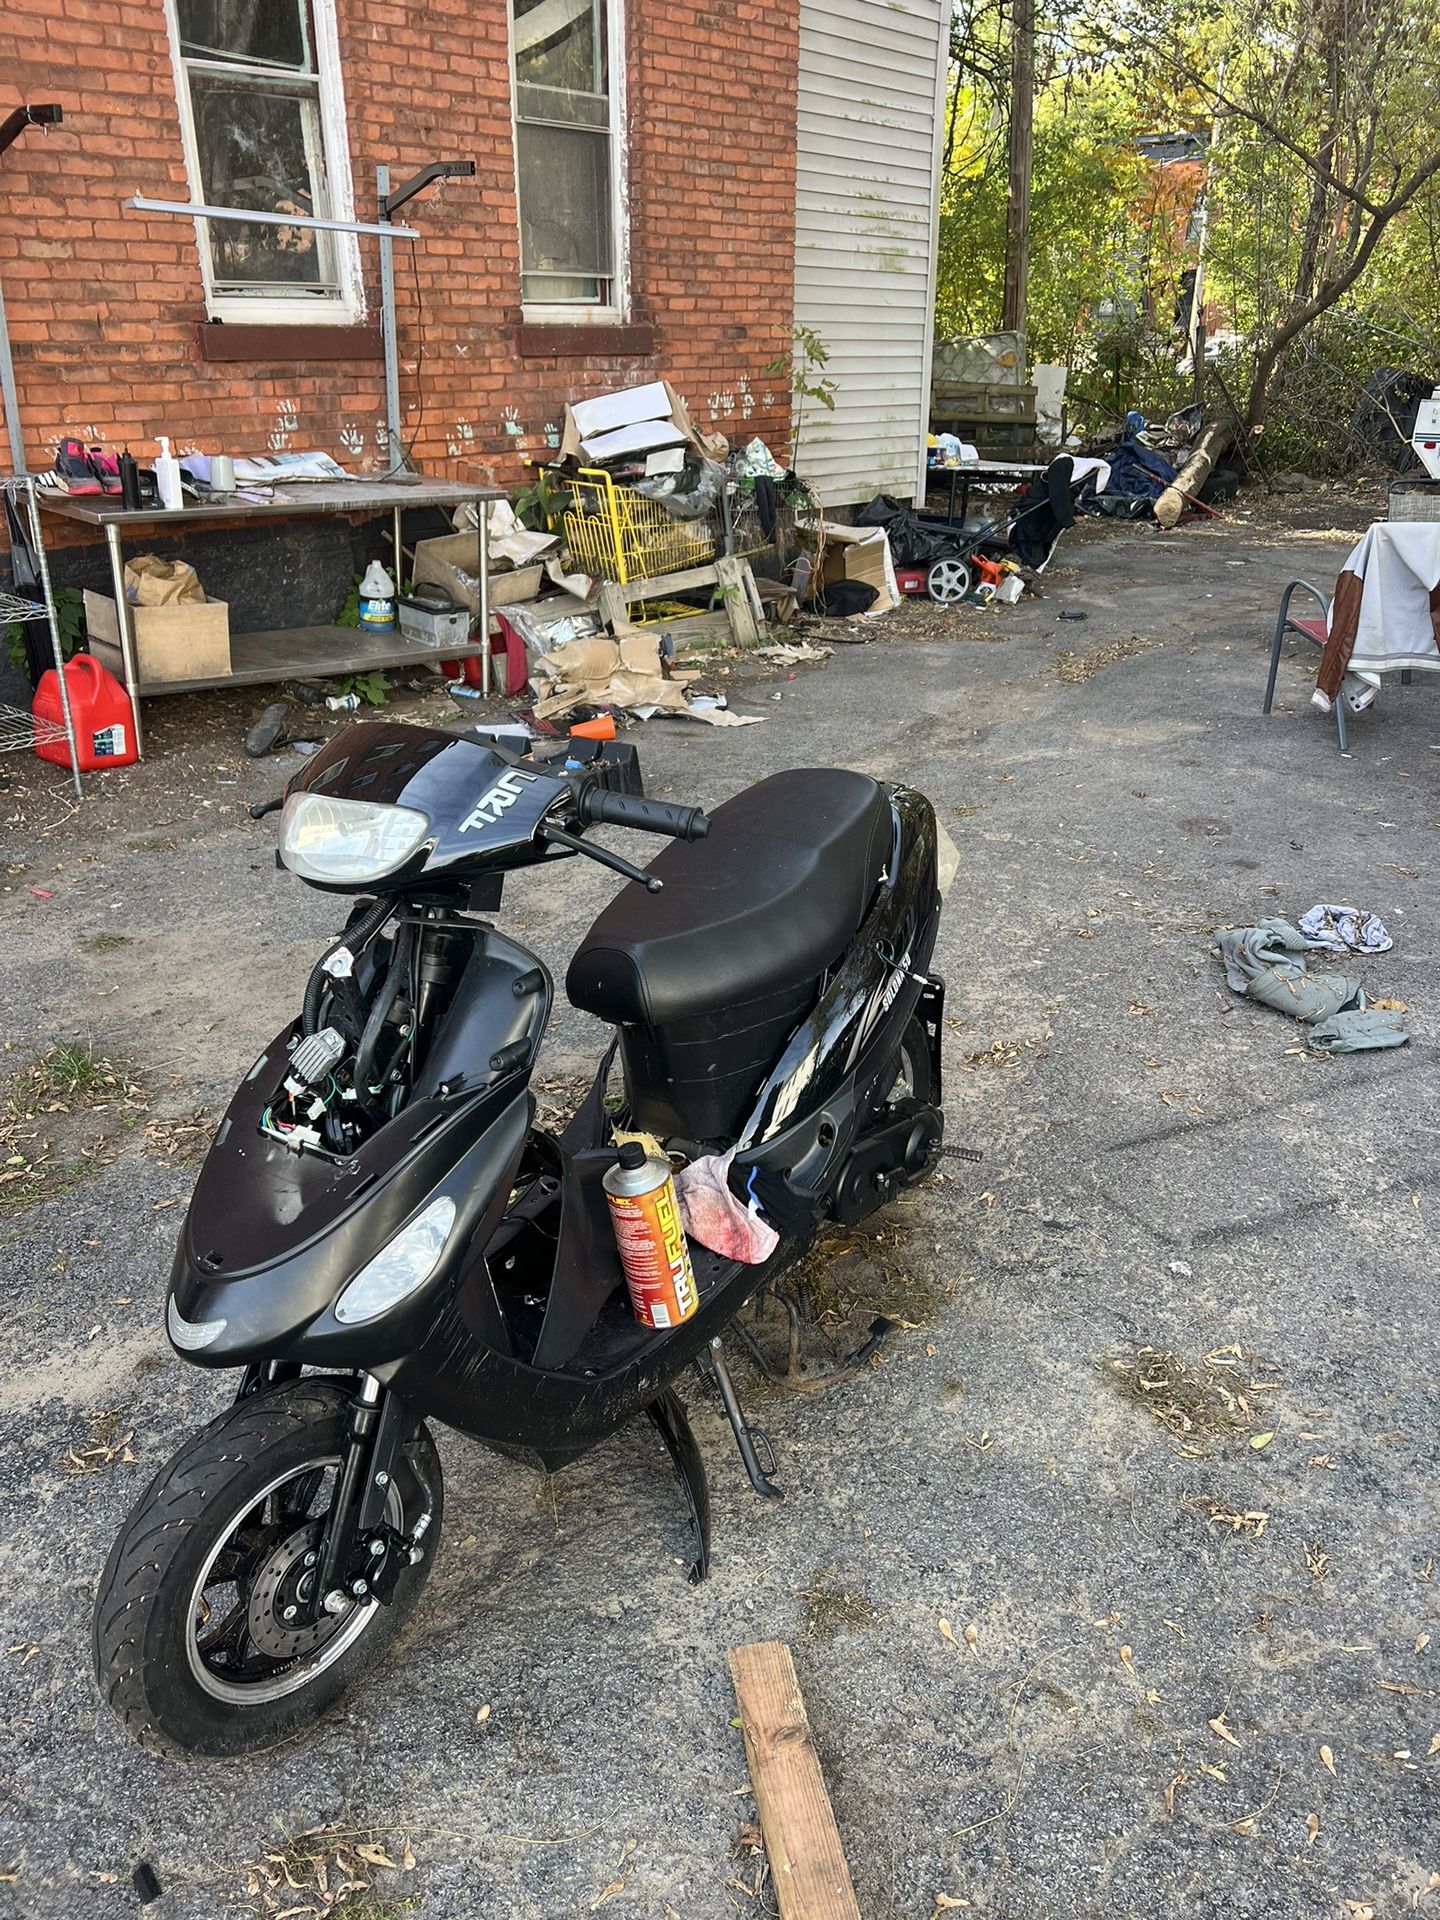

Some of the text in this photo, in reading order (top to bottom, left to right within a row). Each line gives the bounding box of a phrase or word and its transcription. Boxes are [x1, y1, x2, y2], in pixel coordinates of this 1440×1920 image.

[368, 600, 391, 611] Elite
[458, 771, 538, 833] CRF
[655, 1186, 691, 1317] TRUFUEL
